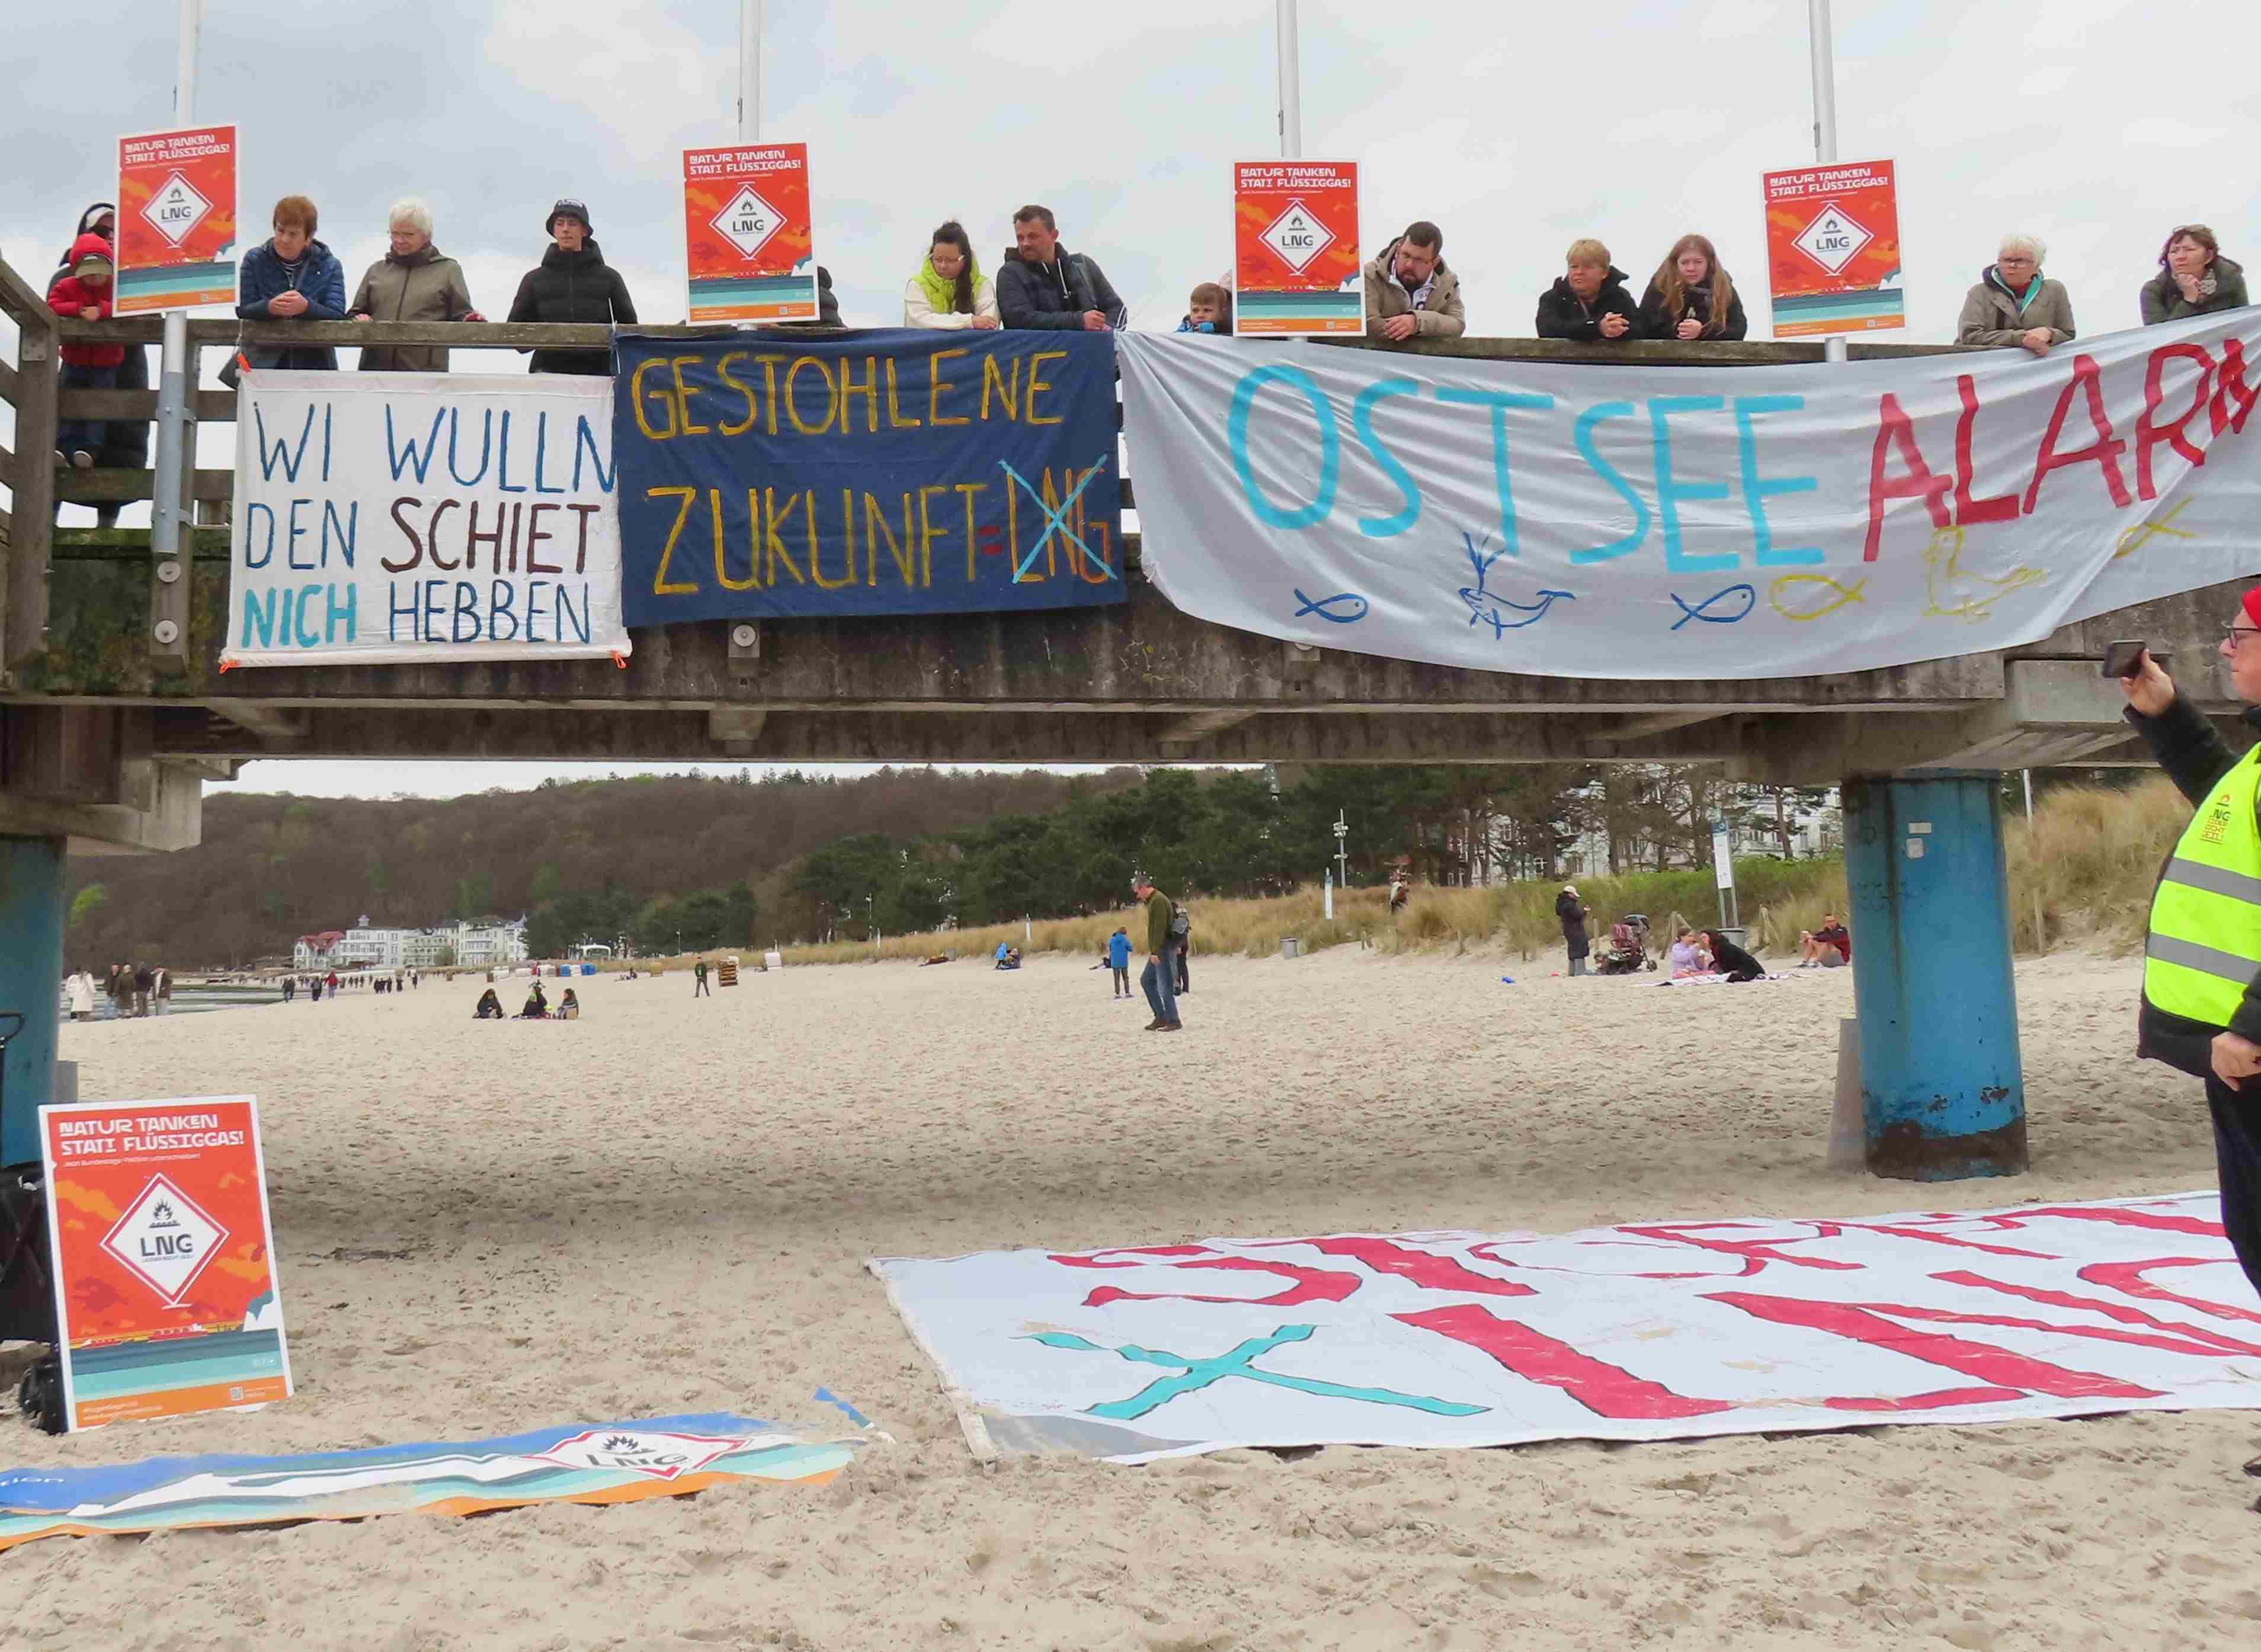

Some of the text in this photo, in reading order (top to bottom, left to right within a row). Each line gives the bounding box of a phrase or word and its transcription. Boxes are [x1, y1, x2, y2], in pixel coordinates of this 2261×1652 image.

[690, 150, 785, 164] NATUR TANKEN
[726, 159, 801, 172] FLÜSSIGGAS!
[1241, 168, 1336, 177] NATUR TANKEN
[1770, 168, 1871, 187] NATUR TANKEN
[1277, 177, 1352, 188] FLÜSSIGGAS!
[1809, 177, 1888, 193] FLÜSSIGGAS!
[161, 206, 191, 220] LNG
[732, 220, 764, 232] LNG
[1282, 235, 1314, 246] LNG
[1816, 236, 1850, 249] LNG
[631, 349, 1067, 440] GESTOHLENE
[254, 401, 617, 493] WI WULLN
[245, 496, 601, 574] DEN SCHIET
[646, 483, 988, 595] ZUKUNFT
[1006, 466, 1111, 584] LNG
[241, 579, 591, 649] NICH HEBBEN
[59, 1114, 219, 1137] NATUR TANKEN
[61, 1130, 245, 1156] STATT FLÜSSIGGAS!
[140, 1233, 194, 1256] LNG
